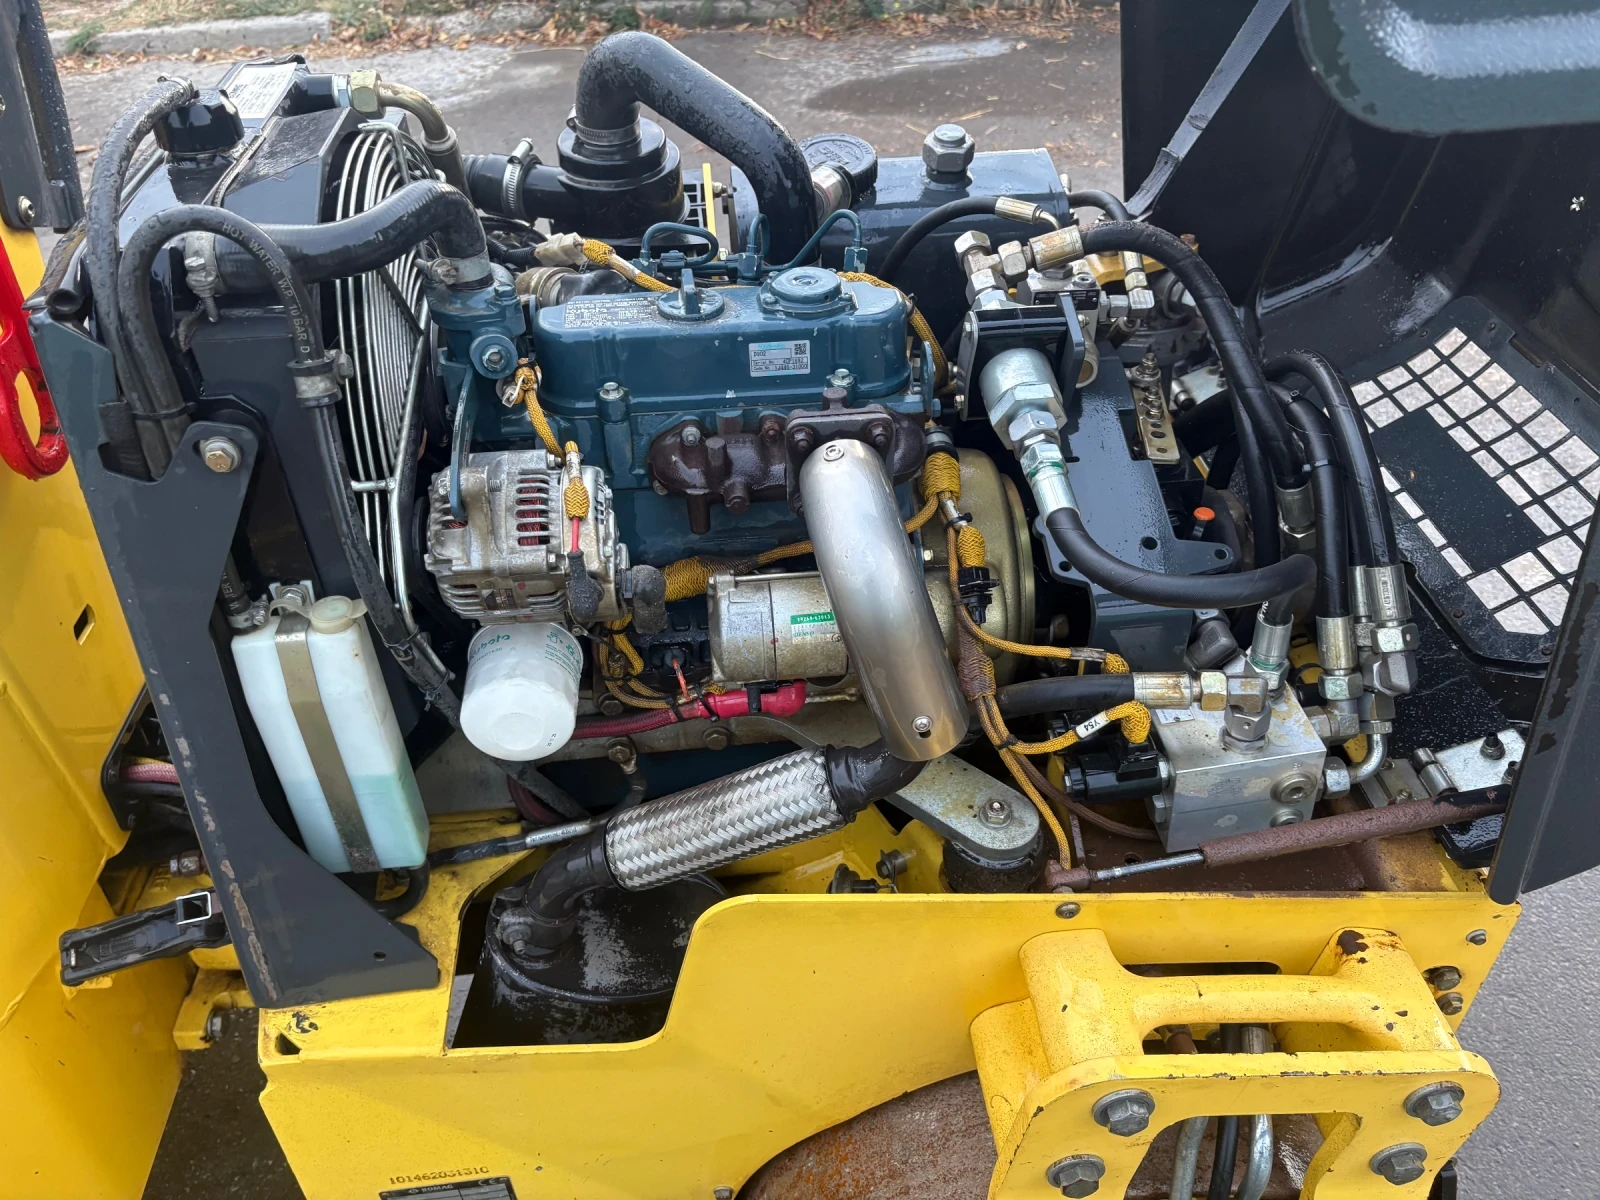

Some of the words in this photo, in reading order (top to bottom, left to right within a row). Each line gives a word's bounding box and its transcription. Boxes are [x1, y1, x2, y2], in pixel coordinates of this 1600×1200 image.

[222, 221, 246, 241] HOT
[249, 239, 281, 276] WATER
[289, 303, 300, 316] 10
[293, 318, 308, 341] BAR
[1083, 719, 1101, 732] Y54
[421, 1184, 454, 1193] BOMAG
